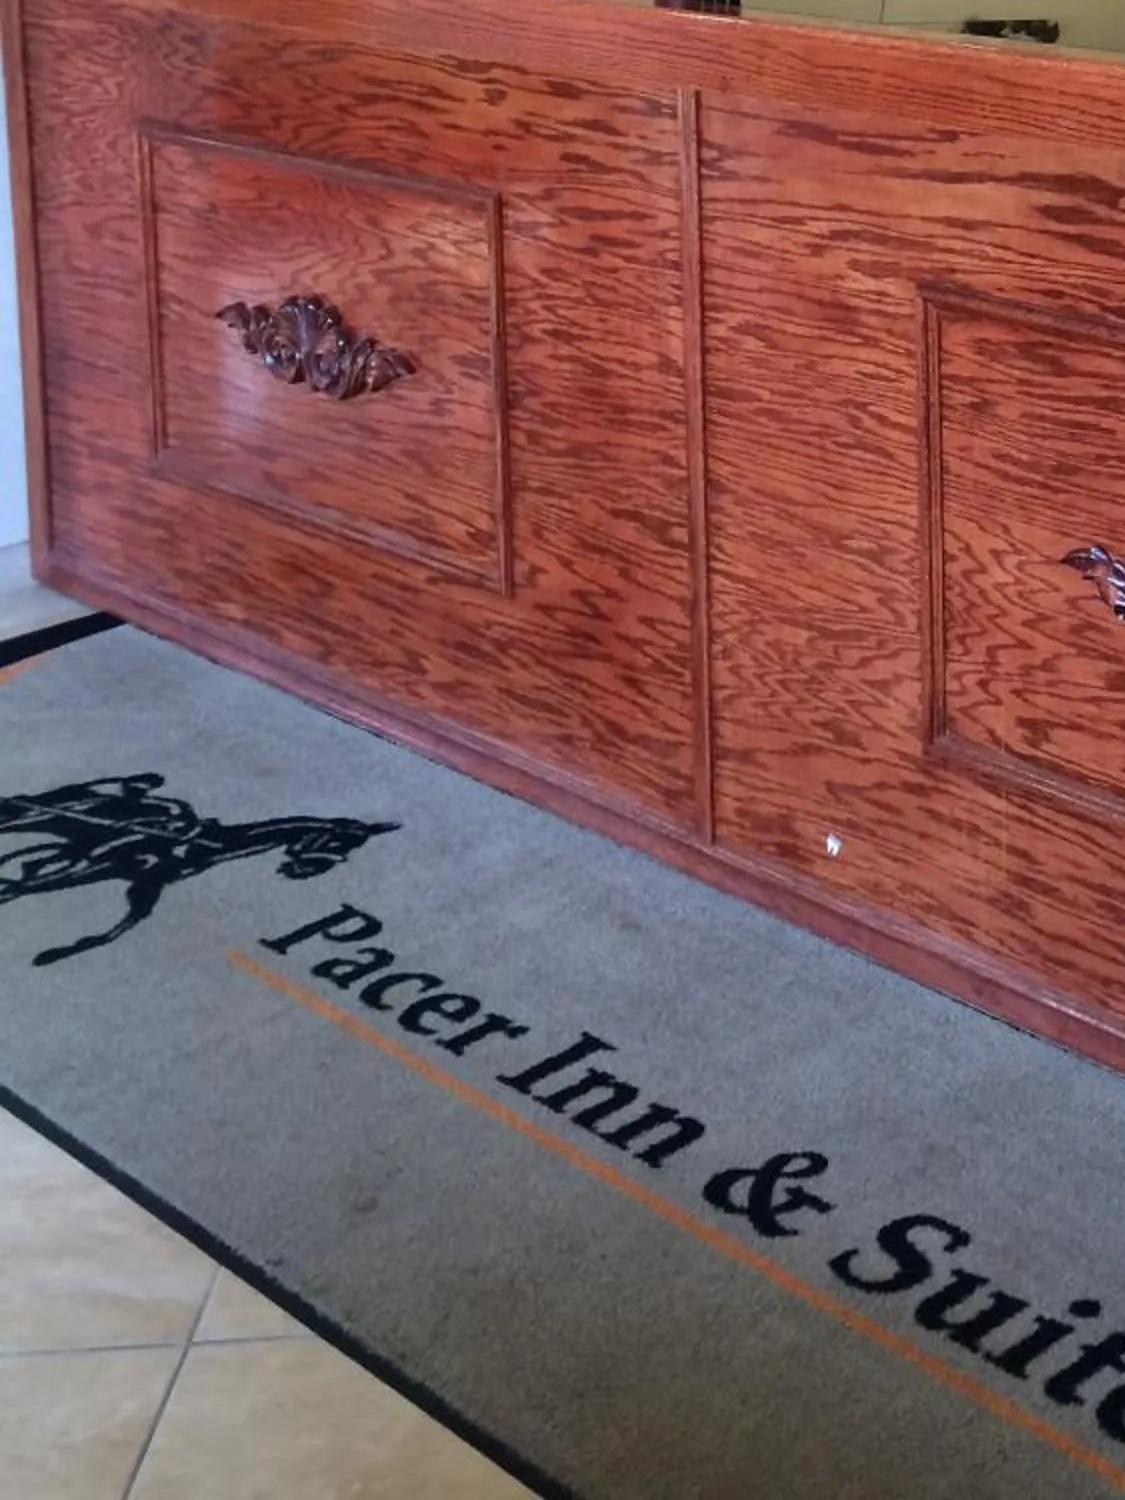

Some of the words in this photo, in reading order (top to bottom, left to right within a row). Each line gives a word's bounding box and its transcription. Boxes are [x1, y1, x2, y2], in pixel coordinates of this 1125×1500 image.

[257, 902, 530, 1058] Pacer
[495, 1030, 706, 1170] Inn
[701, 1150, 833, 1240] &
